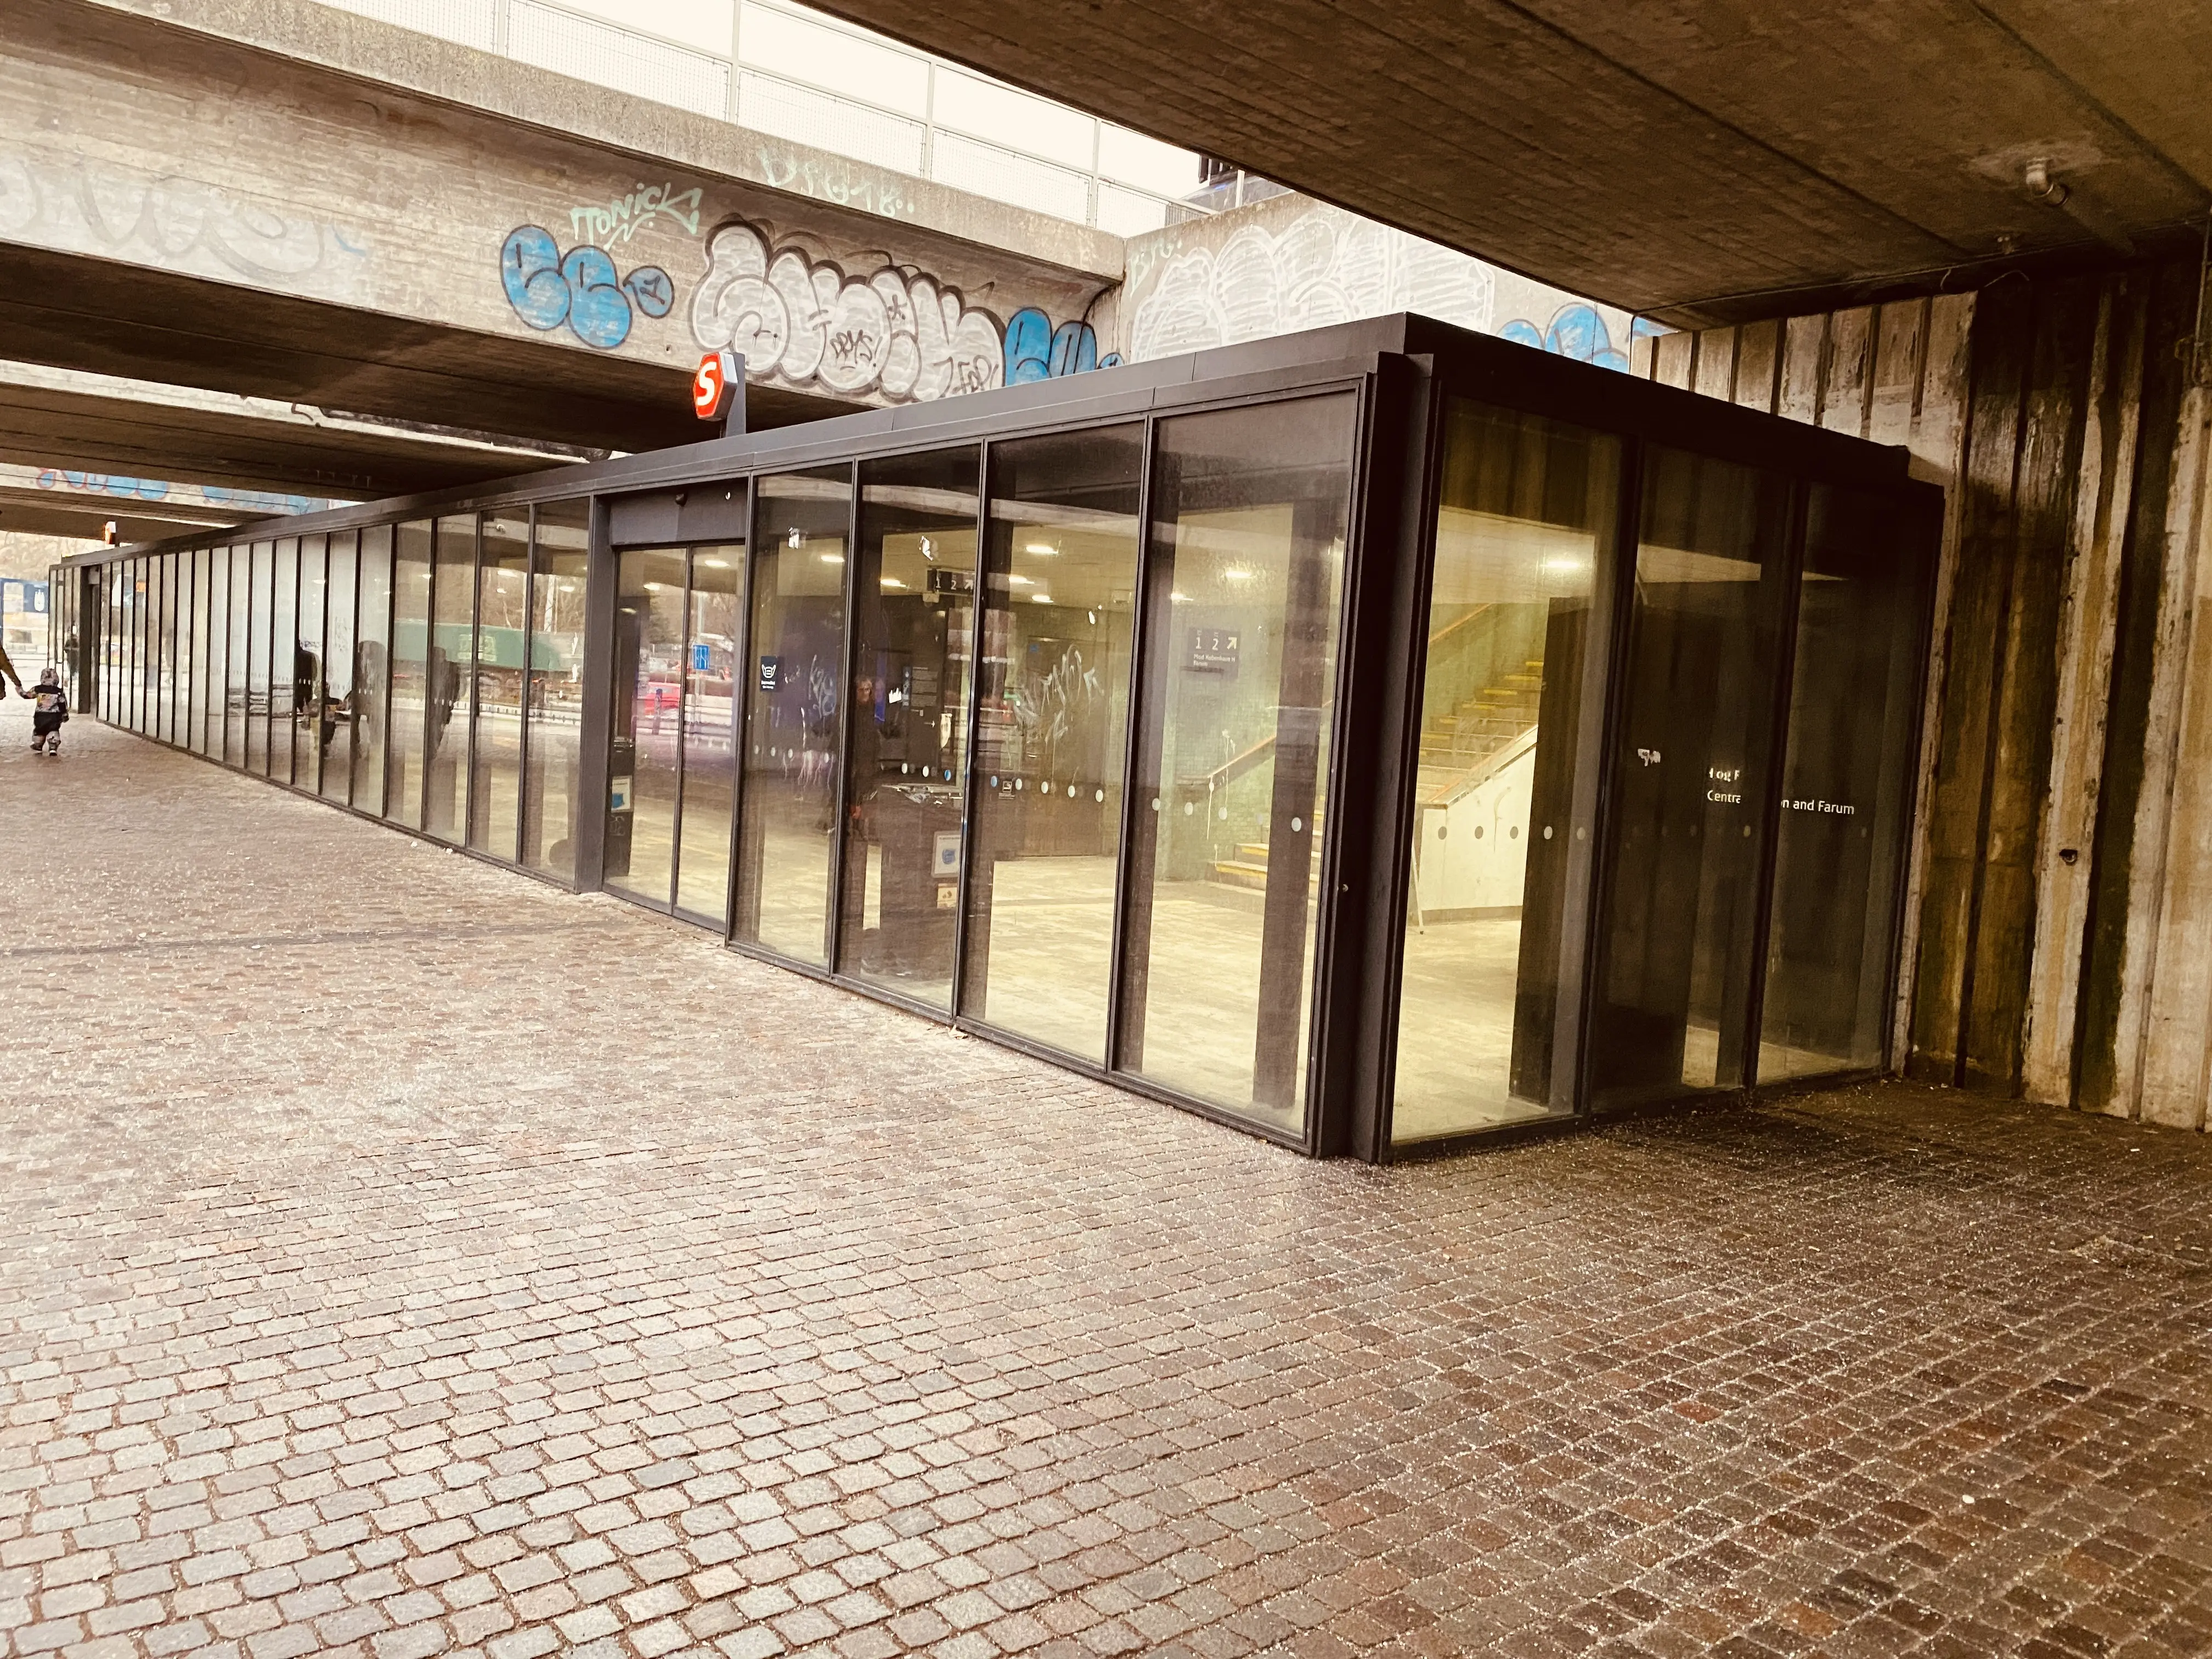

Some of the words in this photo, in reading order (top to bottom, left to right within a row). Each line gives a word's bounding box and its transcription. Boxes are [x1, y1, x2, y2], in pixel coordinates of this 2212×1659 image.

[697, 362, 717, 406] S
[951, 580, 957, 590] 2
[1196, 637, 1201, 650] 1
[1212, 638, 1219, 651] 2
[1793, 799, 1815, 811] and
[1818, 800, 1854, 815] Farum
